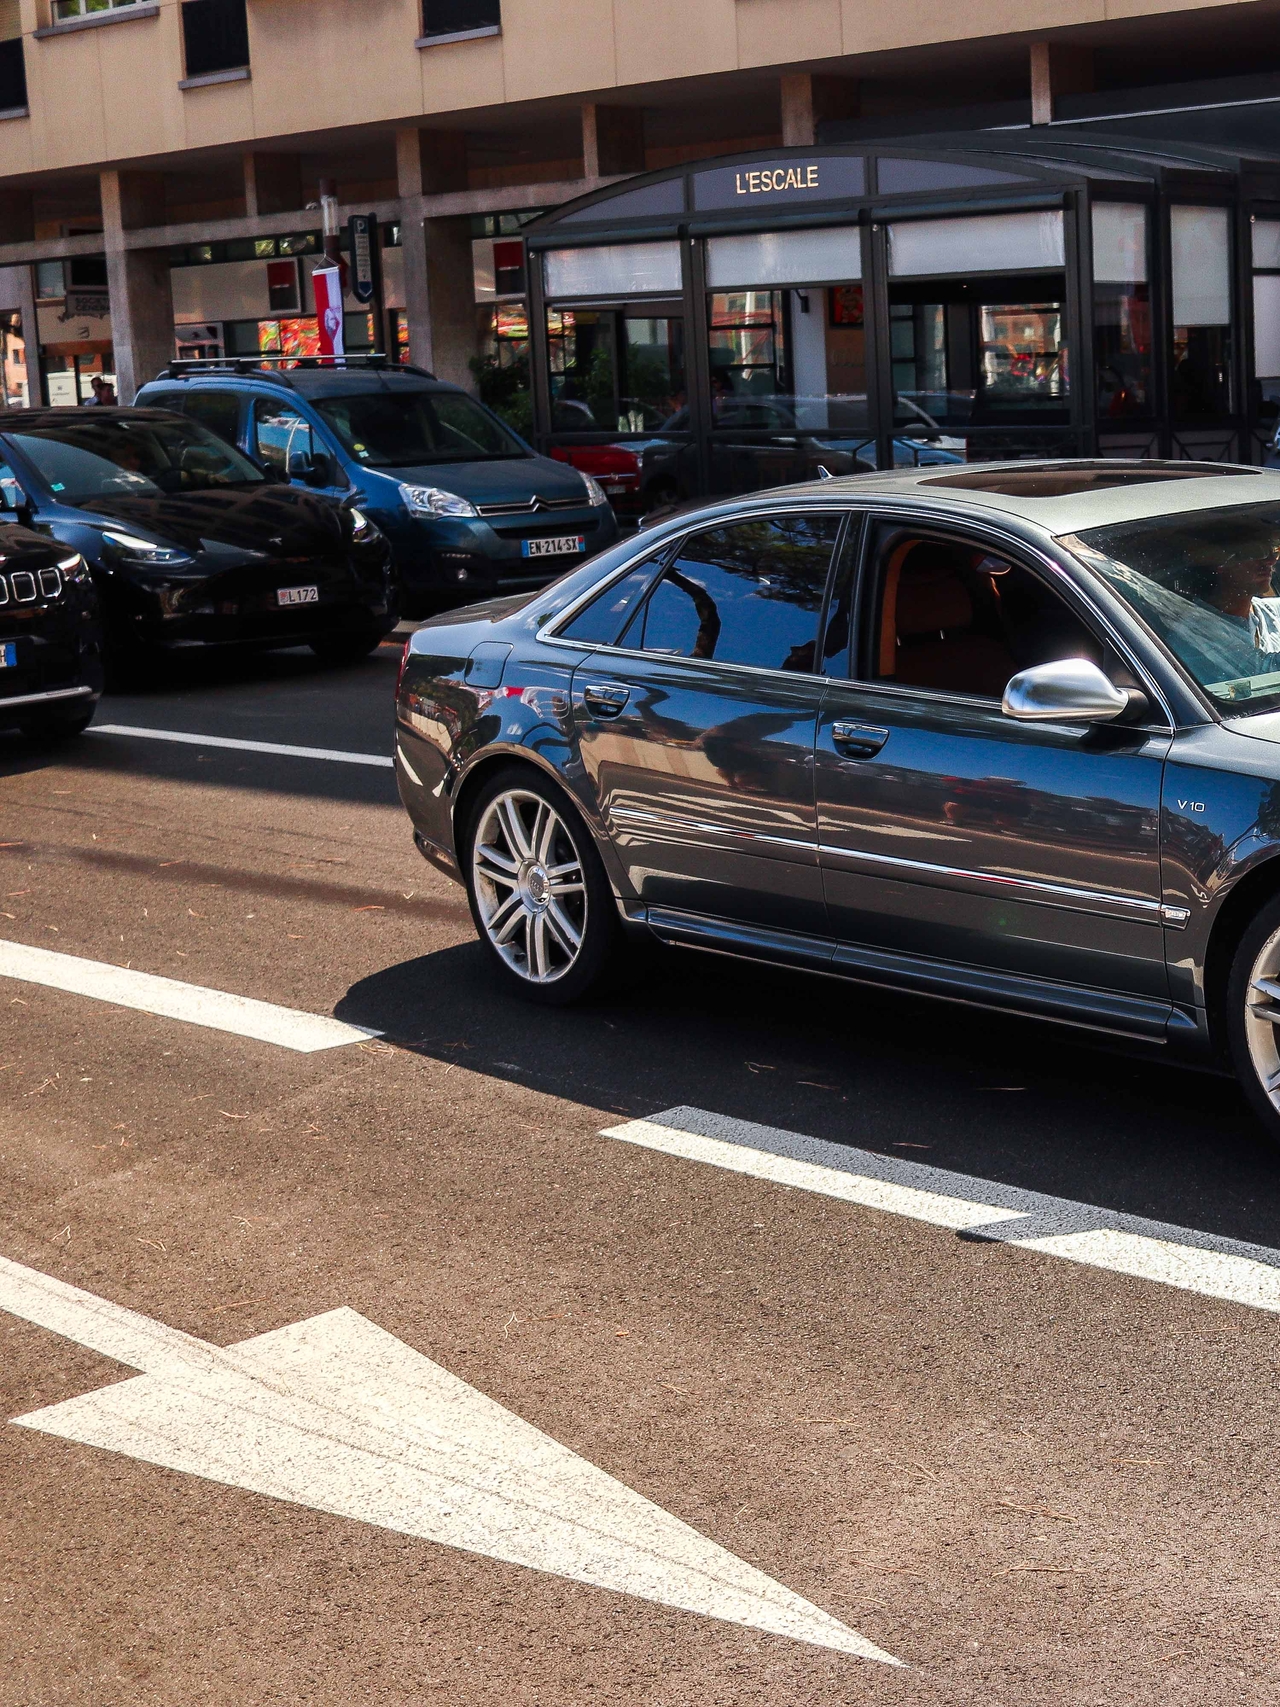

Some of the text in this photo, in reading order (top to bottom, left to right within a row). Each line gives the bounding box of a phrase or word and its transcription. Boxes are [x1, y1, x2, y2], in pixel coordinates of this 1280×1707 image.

[735, 165, 819, 194] L'ESCALE
[288, 588, 317, 603] L172
[1177, 799, 1205, 812] V10
